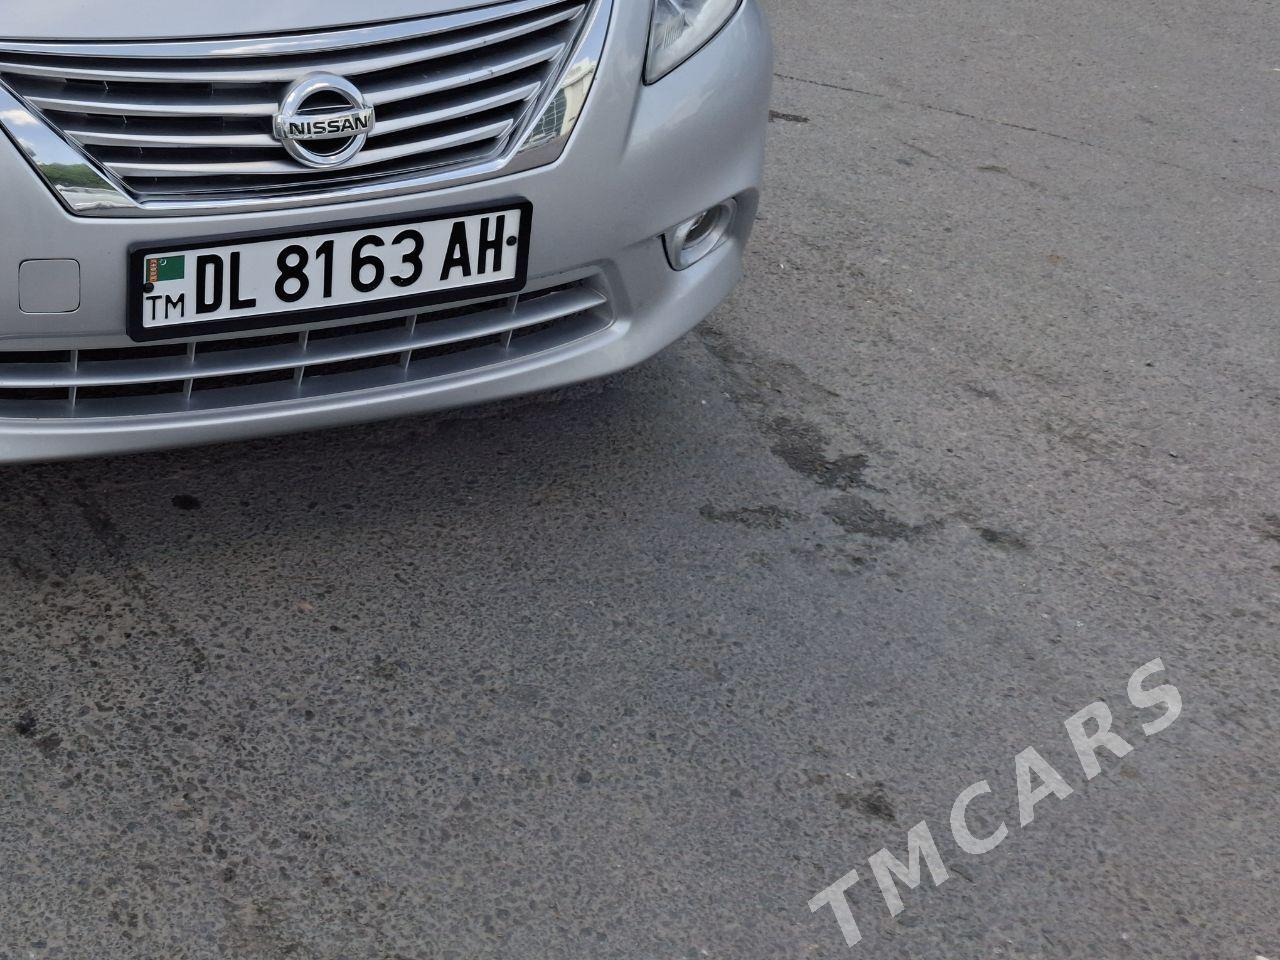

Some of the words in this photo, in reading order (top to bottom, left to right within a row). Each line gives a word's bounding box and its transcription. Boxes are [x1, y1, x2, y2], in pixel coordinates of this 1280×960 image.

[289, 115, 368, 136] NISSAN
[195, 251, 256, 314] DL
[274, 228, 426, 303] 8163
[439, 214, 506, 280] AH
[145, 292, 185, 320] TM
